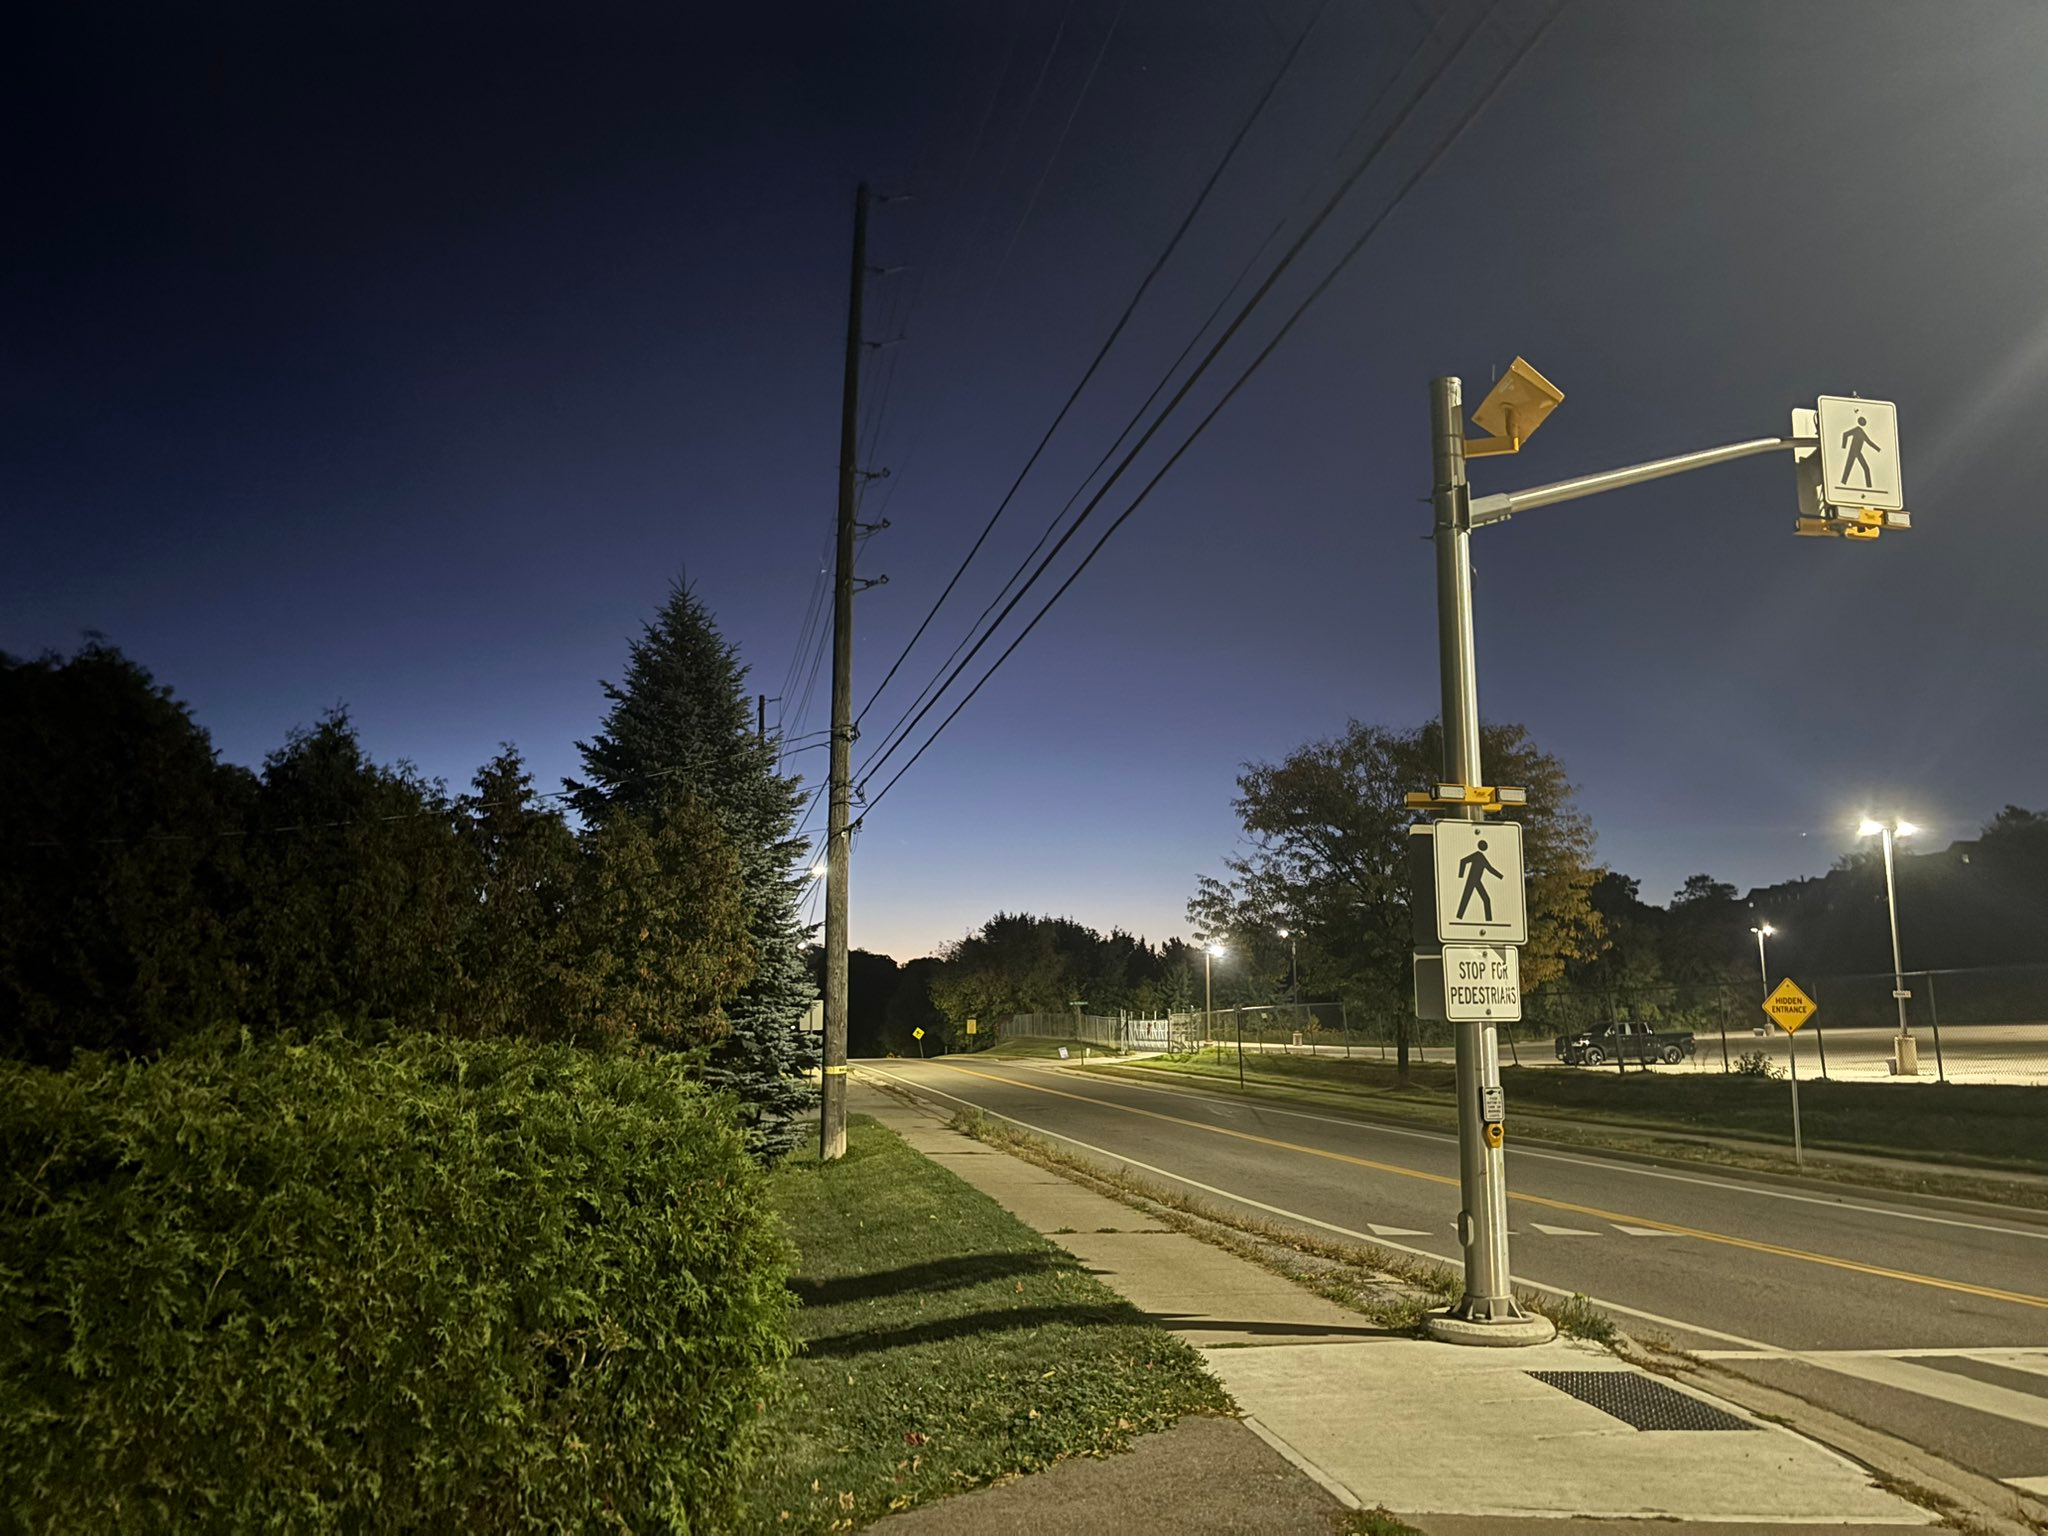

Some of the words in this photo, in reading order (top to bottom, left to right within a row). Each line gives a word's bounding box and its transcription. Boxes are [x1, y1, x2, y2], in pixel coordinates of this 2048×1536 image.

[1458, 961, 1486, 980] STOP
[1491, 961, 1509, 980] FOR
[1450, 986, 1517, 1005] PEDESTRIANS
[1775, 997, 1803, 1005] HIDDEN
[1771, 1005, 1807, 1014] ENTRANCE
